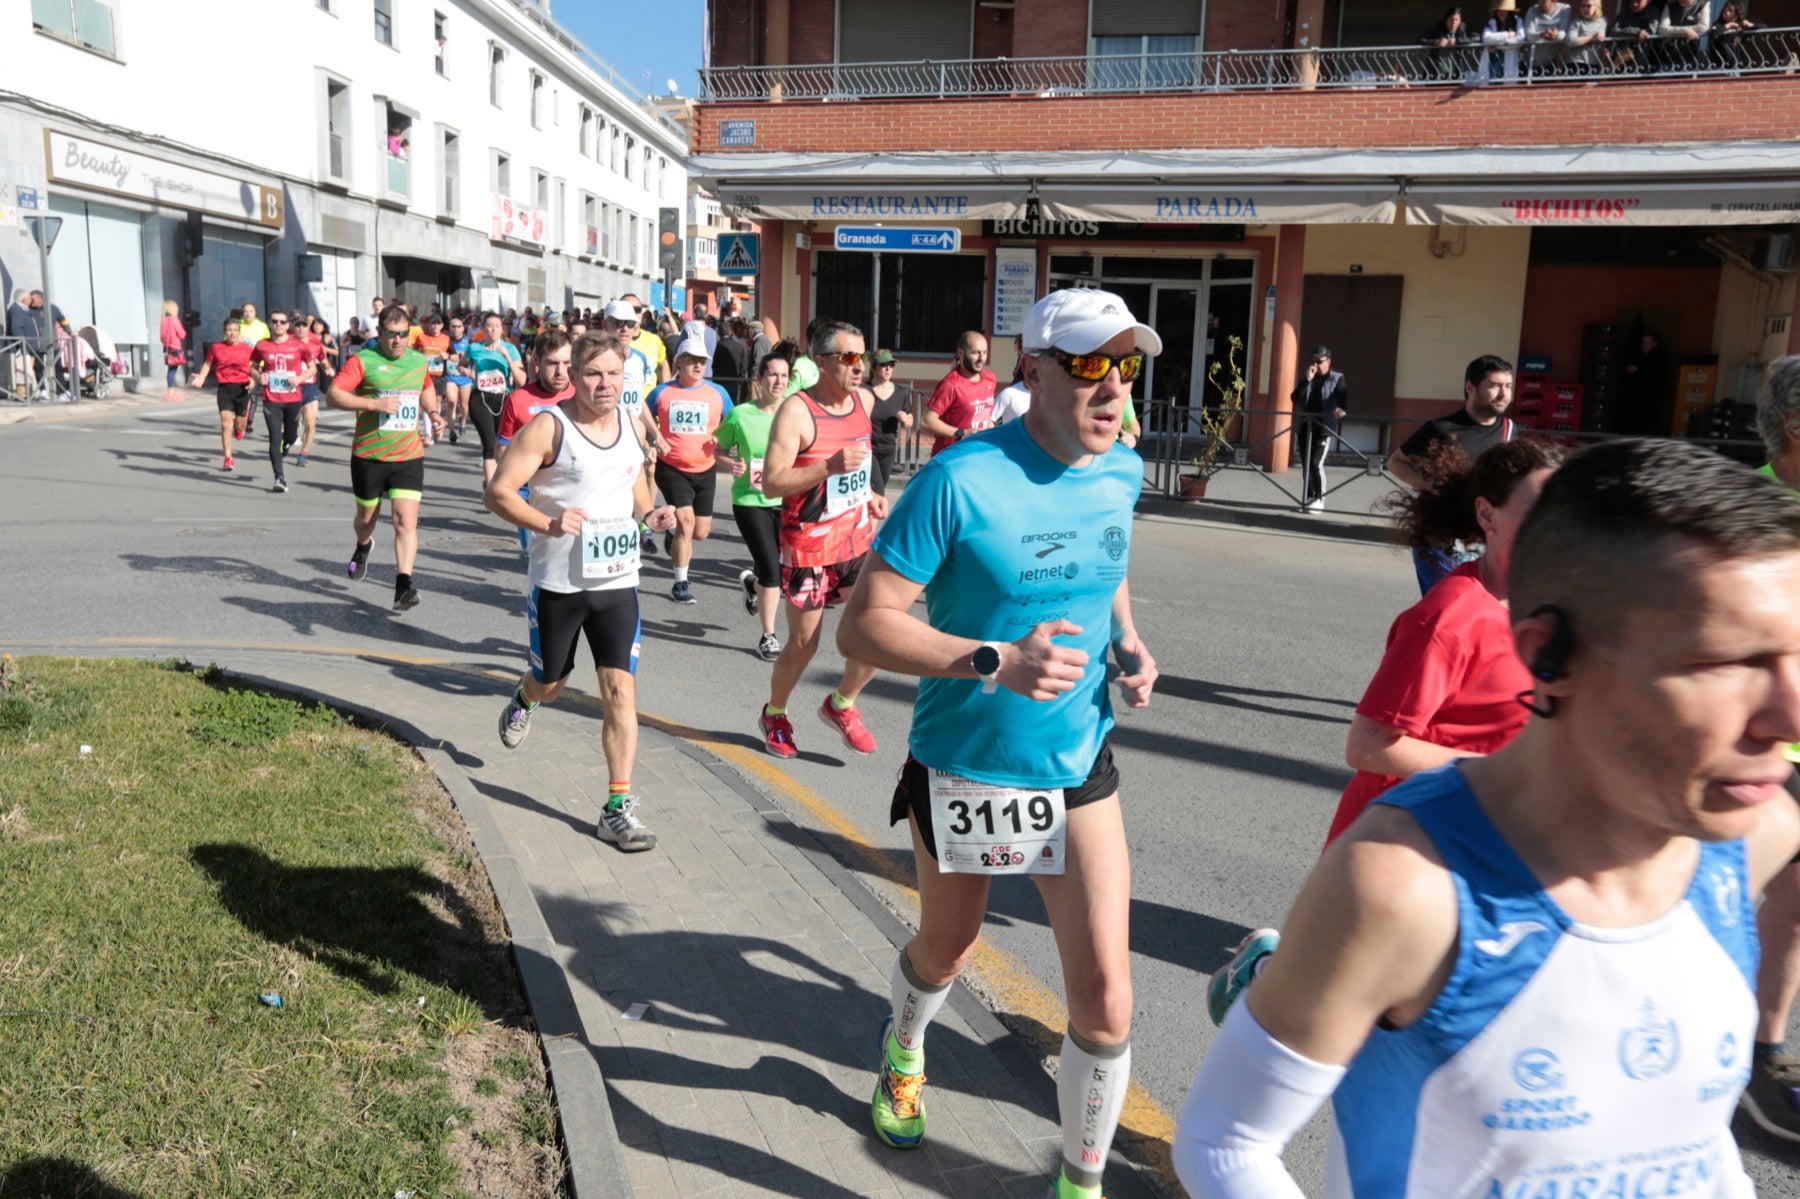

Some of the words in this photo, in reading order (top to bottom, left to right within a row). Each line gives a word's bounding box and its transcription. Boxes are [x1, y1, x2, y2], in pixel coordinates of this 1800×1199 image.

[64, 141, 131, 187] Beauty
[266, 193, 278, 219] B
[811, 196, 969, 216] RESTAURANTE
[1154, 197, 1259, 218] PARADA
[993, 219, 1100, 236] BICHITOS
[838, 233, 887, 245] Granada
[480, 374, 504, 388] 2244
[676, 411, 701, 424] 821
[838, 470, 867, 494] 569
[588, 530, 637, 558] 1094
[1021, 531, 1077, 544] BROOKS
[947, 796, 1054, 835] 3119
